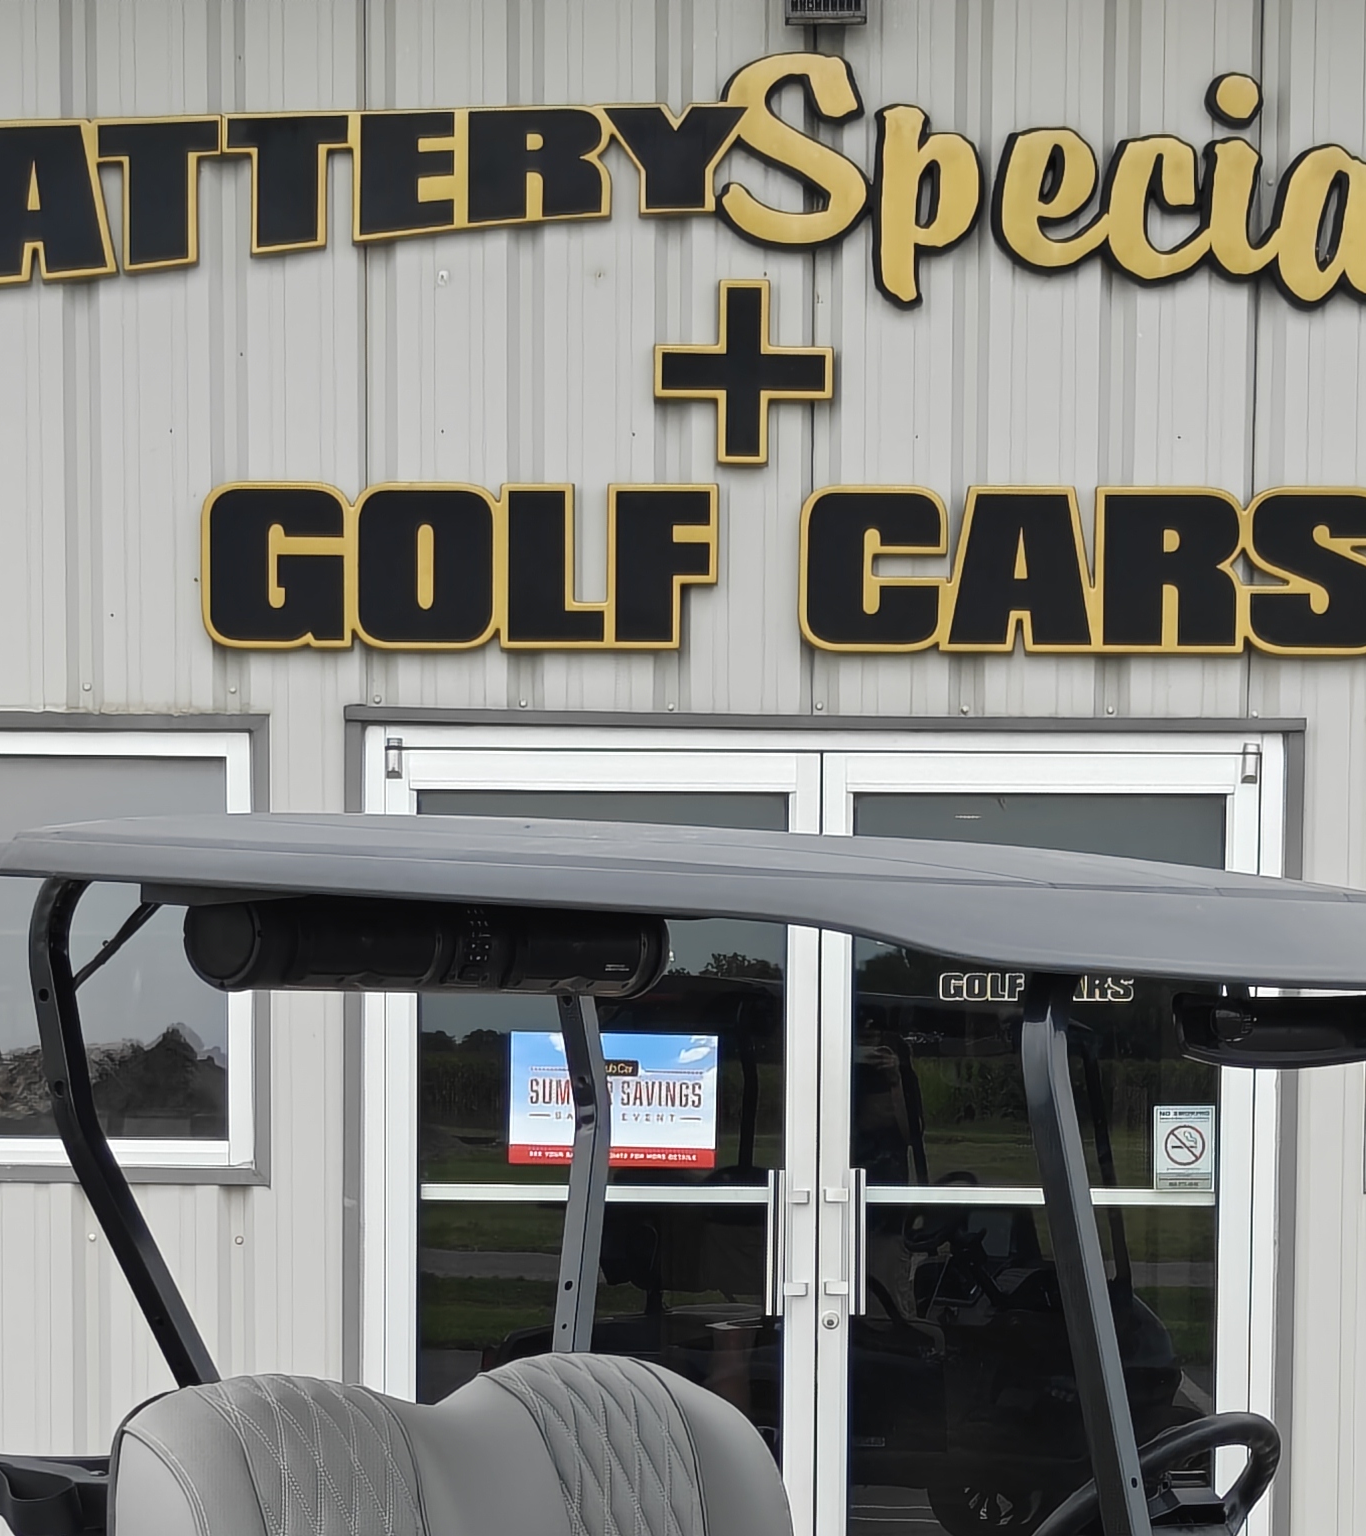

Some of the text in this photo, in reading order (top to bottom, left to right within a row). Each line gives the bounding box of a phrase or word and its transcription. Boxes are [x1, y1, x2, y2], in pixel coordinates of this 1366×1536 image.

[201, 481, 719, 651] GOLF
[939, 972, 1135, 1002] GOLF RS
[620, 1081, 703, 1108] SAVINGS
[621, 1112, 676, 1123] EVENT
